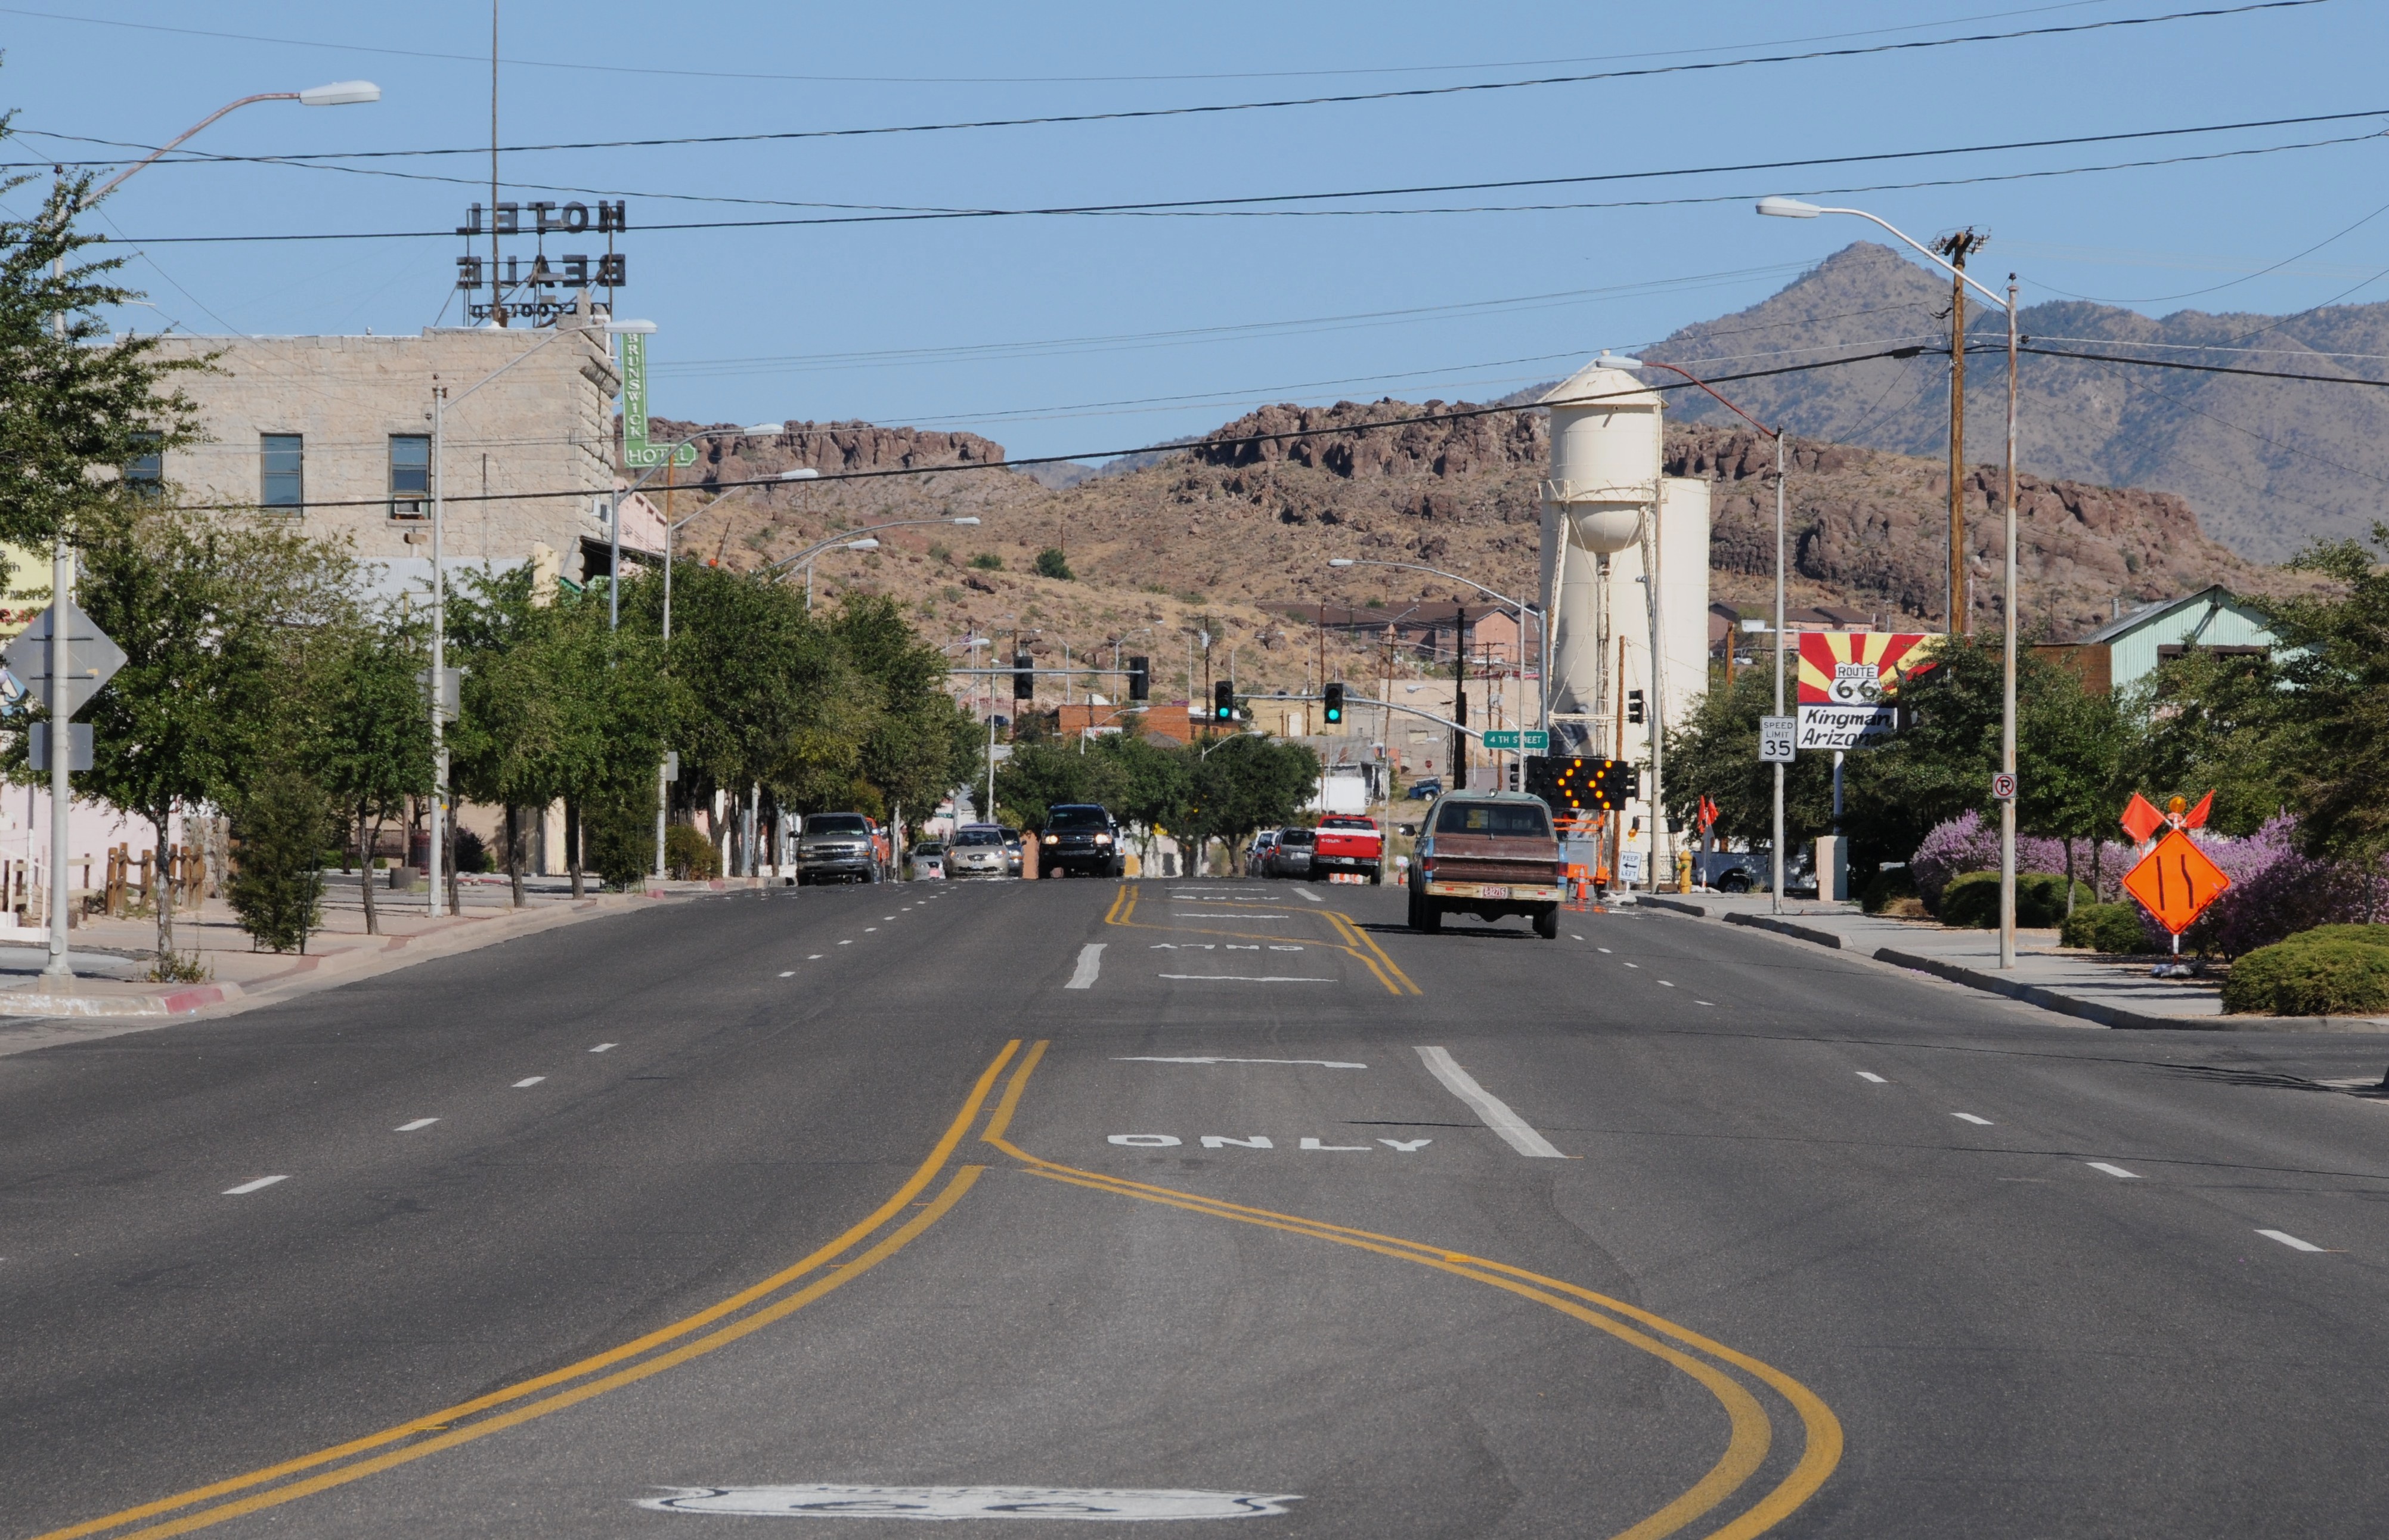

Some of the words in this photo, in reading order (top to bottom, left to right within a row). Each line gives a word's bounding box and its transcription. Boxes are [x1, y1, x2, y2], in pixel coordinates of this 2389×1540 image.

[627, 334, 642, 437] BRUNSWICK
[628, 448, 689, 463] HOTL
[1838, 667, 1874, 677] ROUTE
[1836, 679, 1877, 699] 66
[1765, 740, 1790, 756] 35
[1107, 1134, 1432, 1152] ONLY
